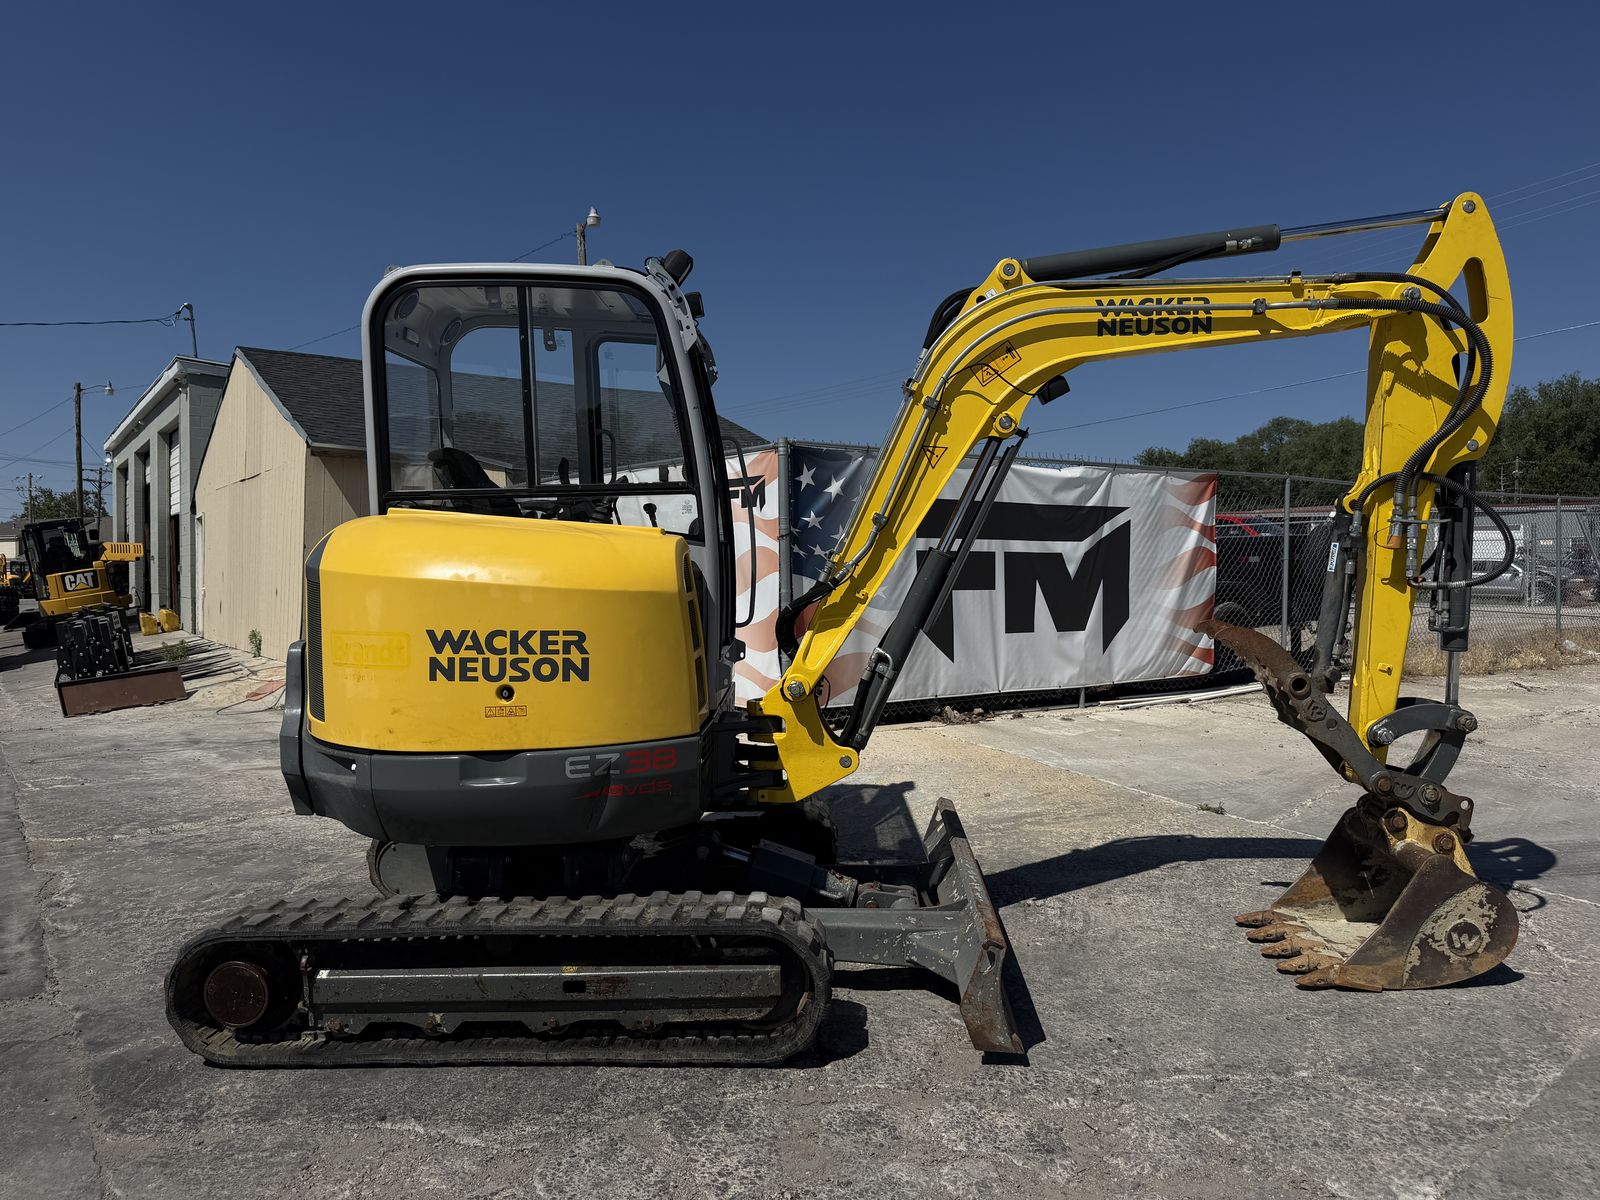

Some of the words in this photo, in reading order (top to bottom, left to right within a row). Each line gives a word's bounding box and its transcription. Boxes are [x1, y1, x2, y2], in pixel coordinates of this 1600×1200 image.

[1095, 297, 1213, 318] WACKER
[1097, 316, 1213, 337] NEUSON
[64, 573, 94, 591] CAT
[425, 629, 590, 656] WACKER
[428, 656, 590, 683] NEUSON
[565, 746, 678, 779] EZ38
